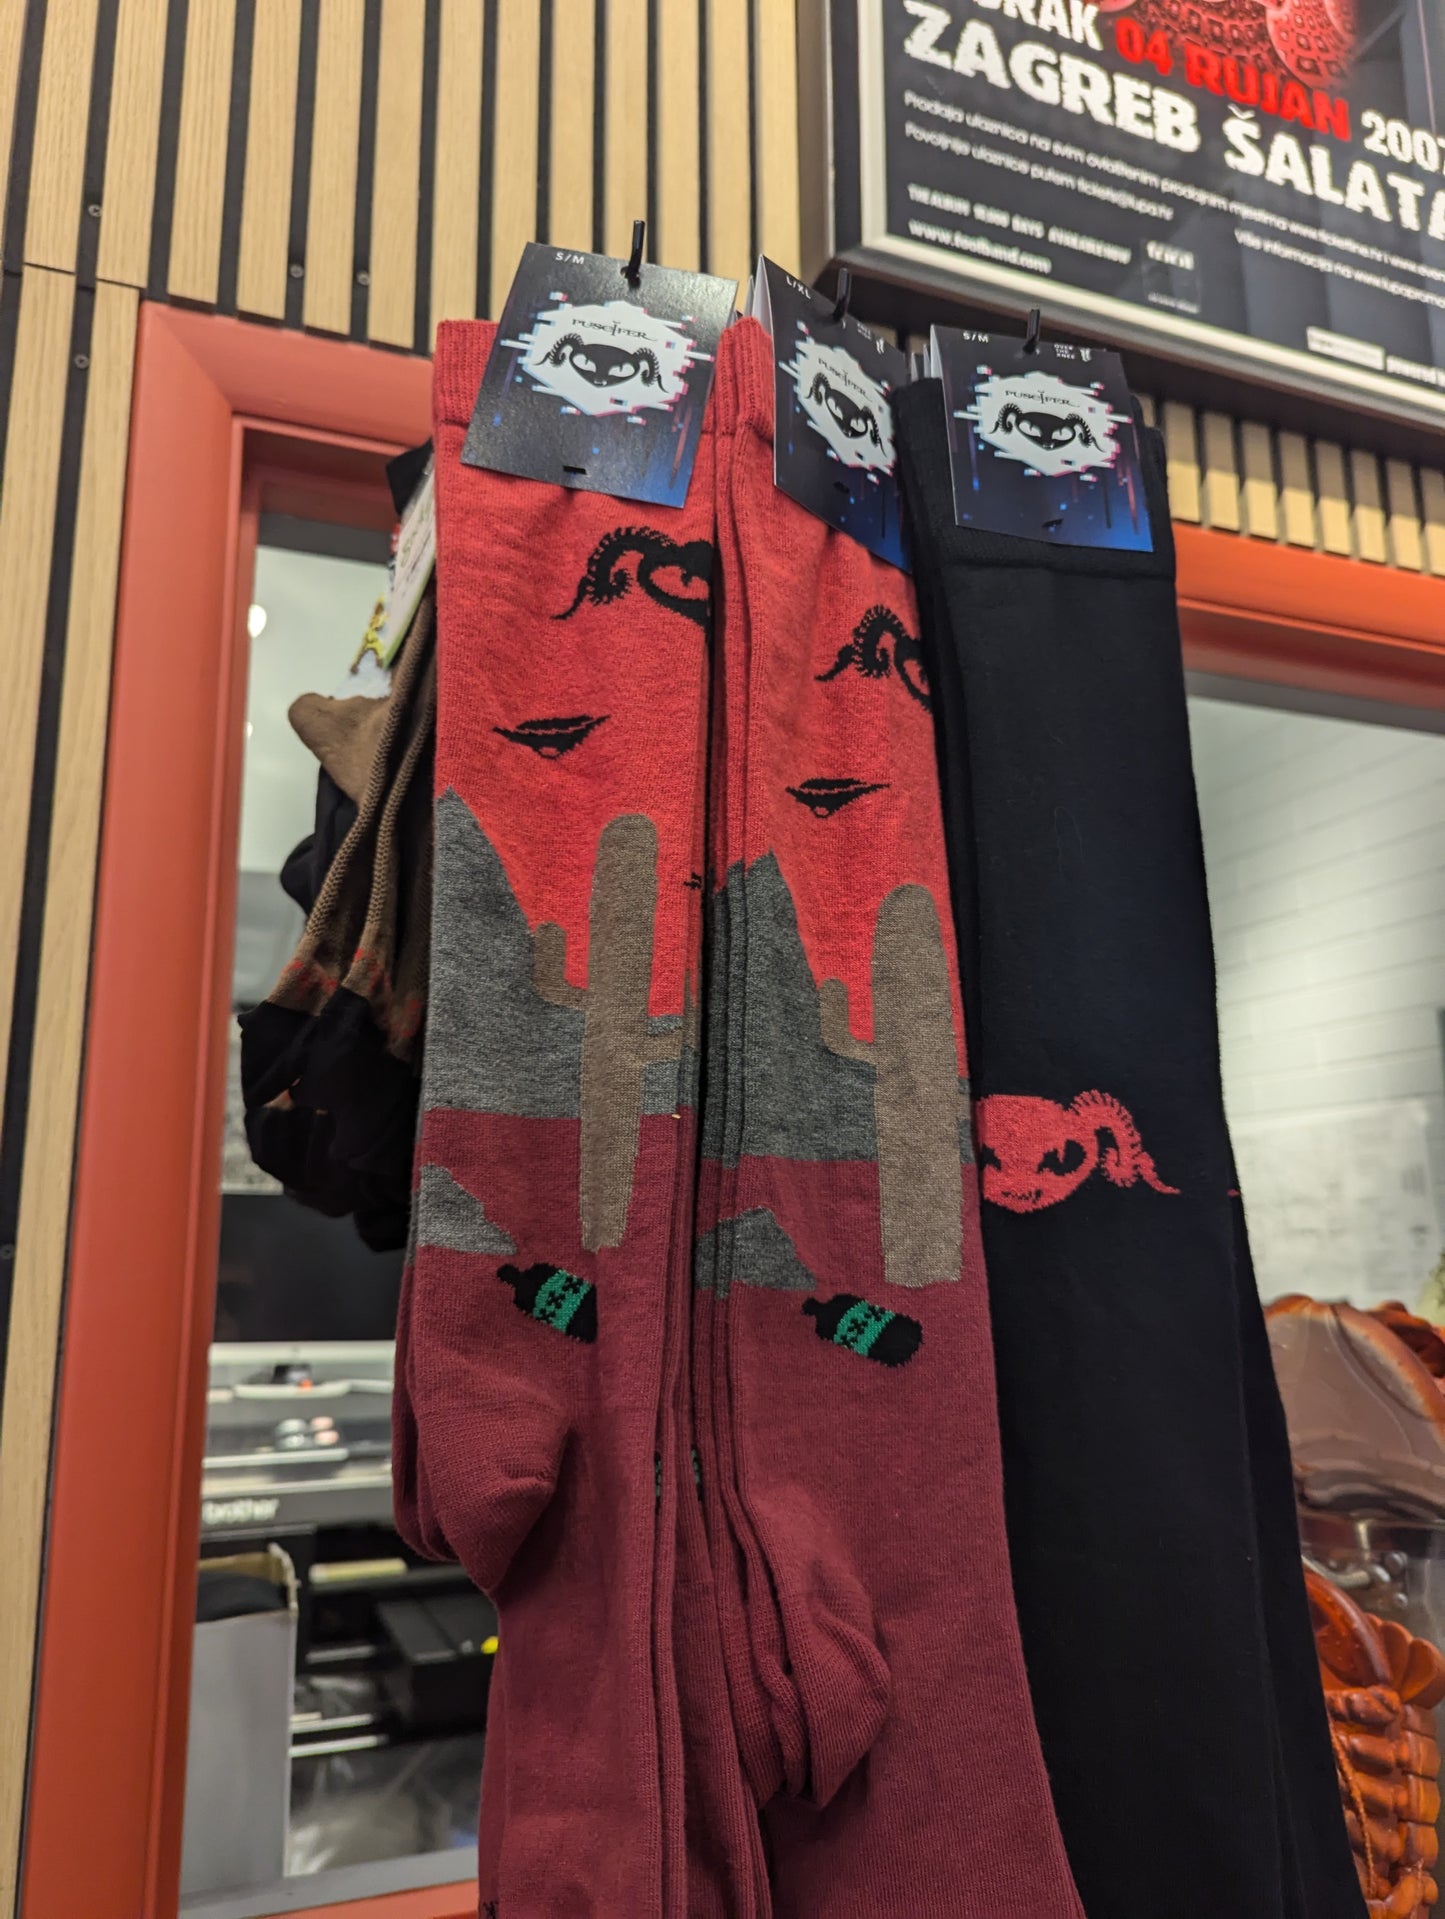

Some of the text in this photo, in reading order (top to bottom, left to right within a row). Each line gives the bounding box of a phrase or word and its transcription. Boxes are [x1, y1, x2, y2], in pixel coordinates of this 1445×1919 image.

[904, 0, 1201, 152] ZAGREB
[972, 0, 1103, 50] RAK
[1115, 17, 1174, 76] 04
[1184, 43, 1351, 142] RUJAN
[904, 89, 964, 123] Prodaja
[1029, 133, 1051, 152] na
[555, 252, 585, 265] S/M
[786, 275, 811, 299] L/XL
[963, 331, 989, 343] S/M
